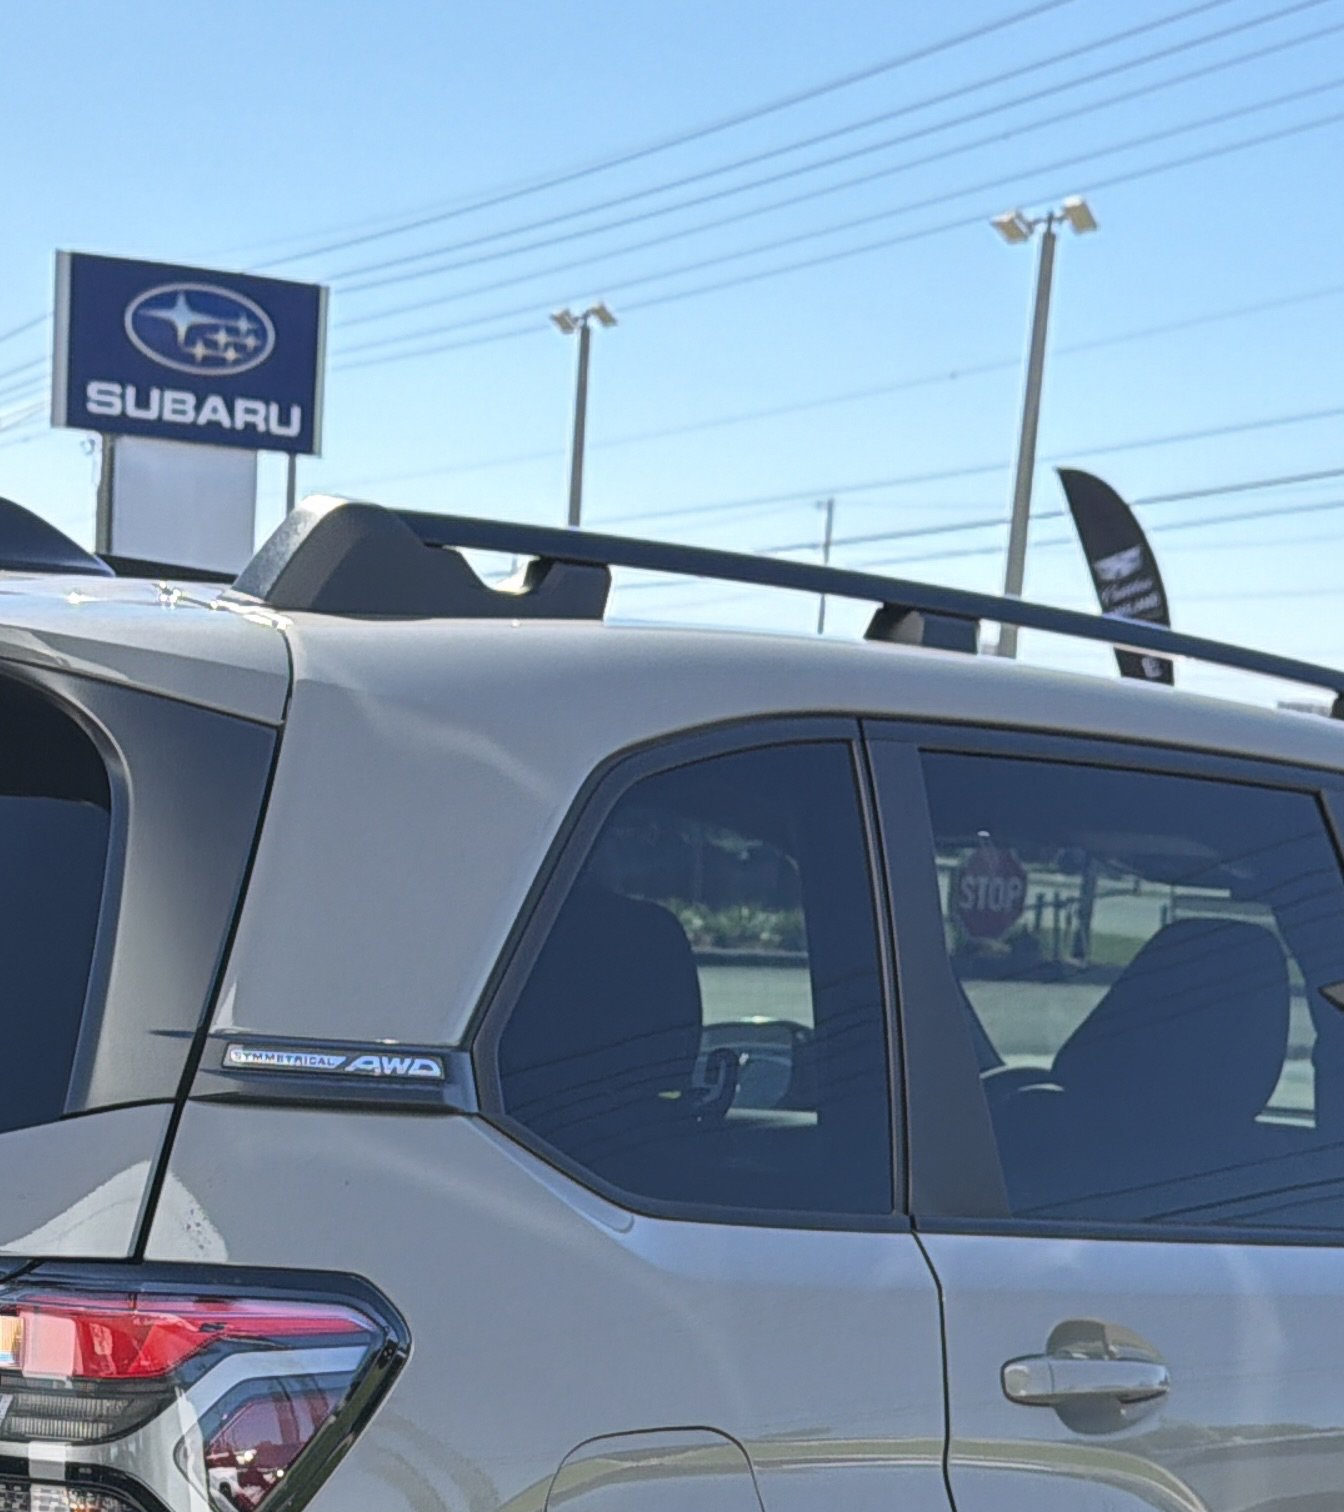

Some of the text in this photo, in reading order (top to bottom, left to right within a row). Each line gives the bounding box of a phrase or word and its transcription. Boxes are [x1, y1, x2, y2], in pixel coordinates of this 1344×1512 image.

[86, 380, 301, 437] SUBARU
[959, 876, 1023, 912] STOP
[232, 1050, 442, 1077] SYMMETRICAL AWD
